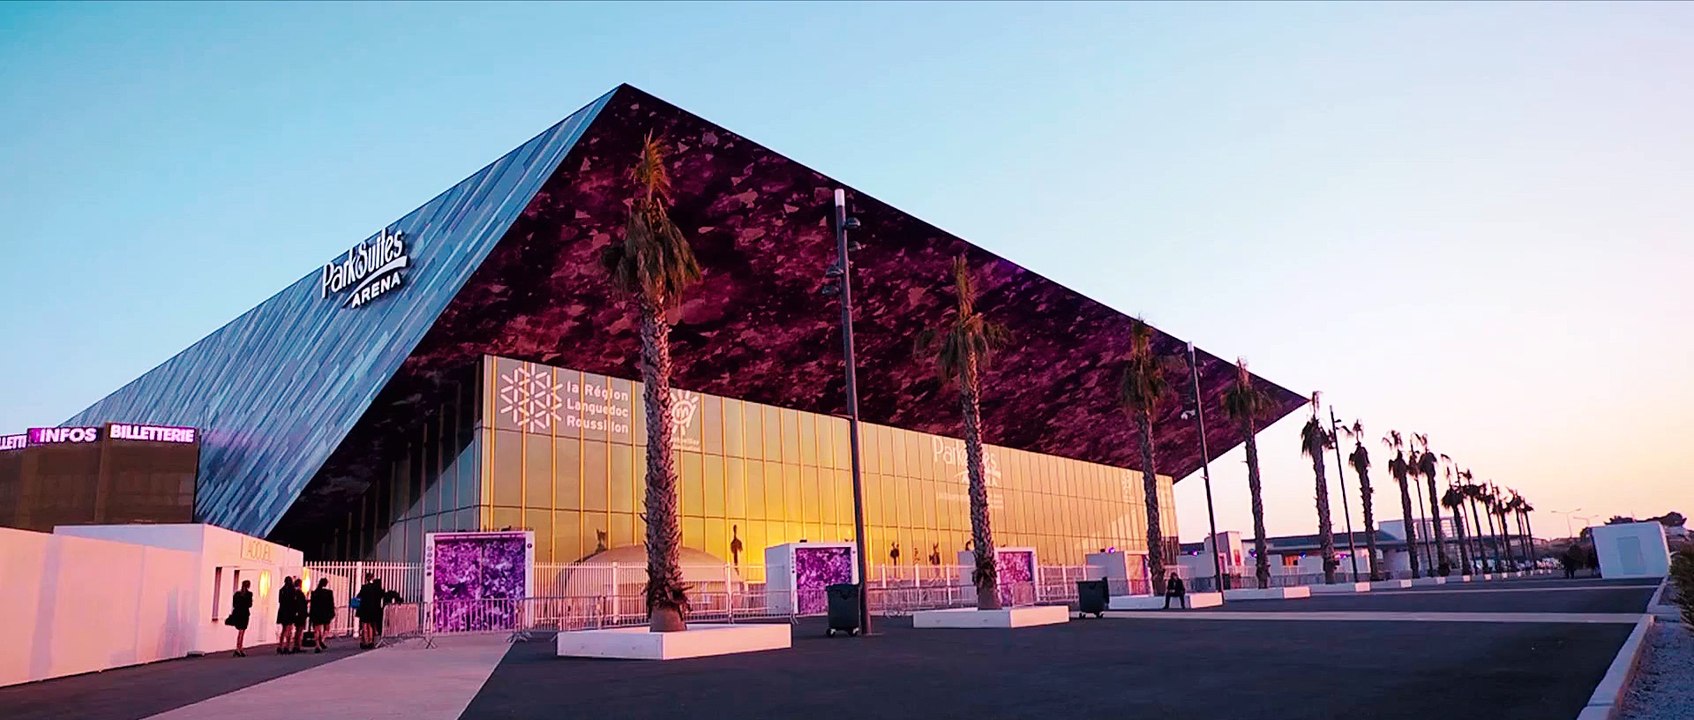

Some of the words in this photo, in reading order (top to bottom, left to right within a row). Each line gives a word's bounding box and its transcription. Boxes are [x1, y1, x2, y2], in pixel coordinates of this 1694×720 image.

[352, 271, 400, 308] ARENA
[566, 381, 580, 394] la
[585, 384, 629, 402] Région
[566, 397, 629, 418] Languedoc
[40, 427, 97, 443] INFOS
[109, 424, 196, 443] BILLETTERIE
